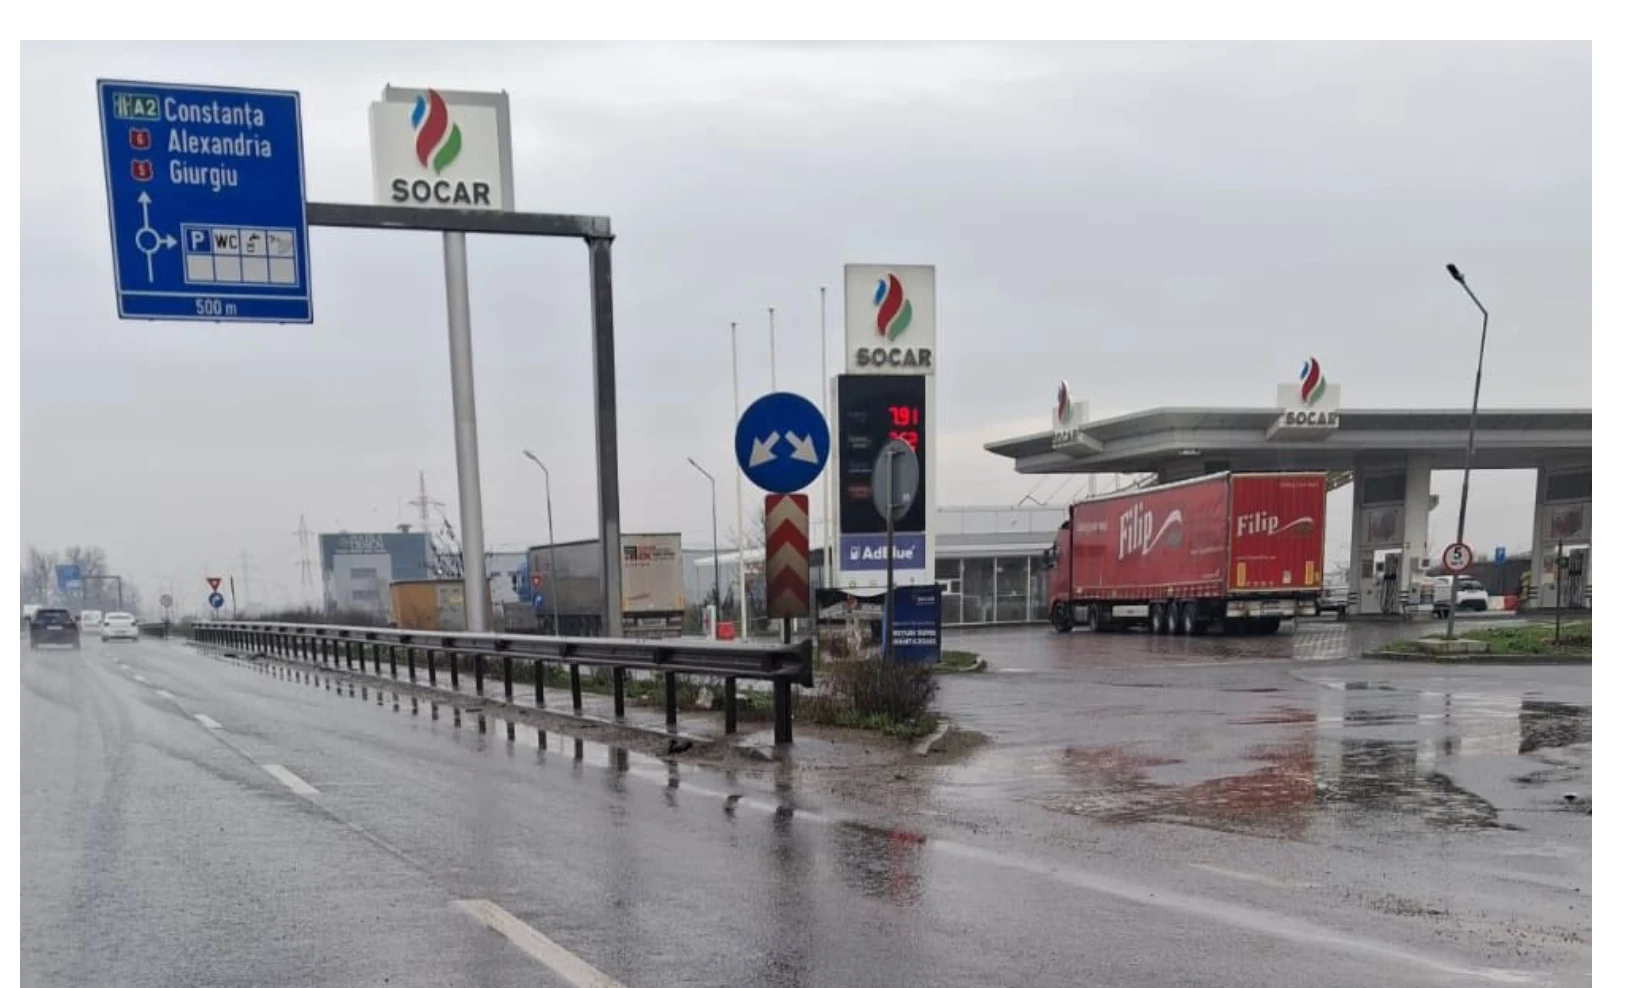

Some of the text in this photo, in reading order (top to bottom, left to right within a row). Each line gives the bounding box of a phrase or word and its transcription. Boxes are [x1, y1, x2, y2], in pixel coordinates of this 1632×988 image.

[134, 99, 157, 117] A2
[168, 128, 272, 158] Alexandria
[170, 159, 238, 192] Giurgiu
[392, 178, 491, 206] SOCAR
[191, 230, 205, 251] P
[215, 233, 238, 250] WC
[195, 298, 237, 315] 500 m
[856, 347, 932, 367] SOCAR
[1285, 411, 1336, 426] SOCAR
[1118, 501, 1153, 560] Filip
[1236, 511, 1279, 538] Filip
[1453, 547, 1462, 560] 5
